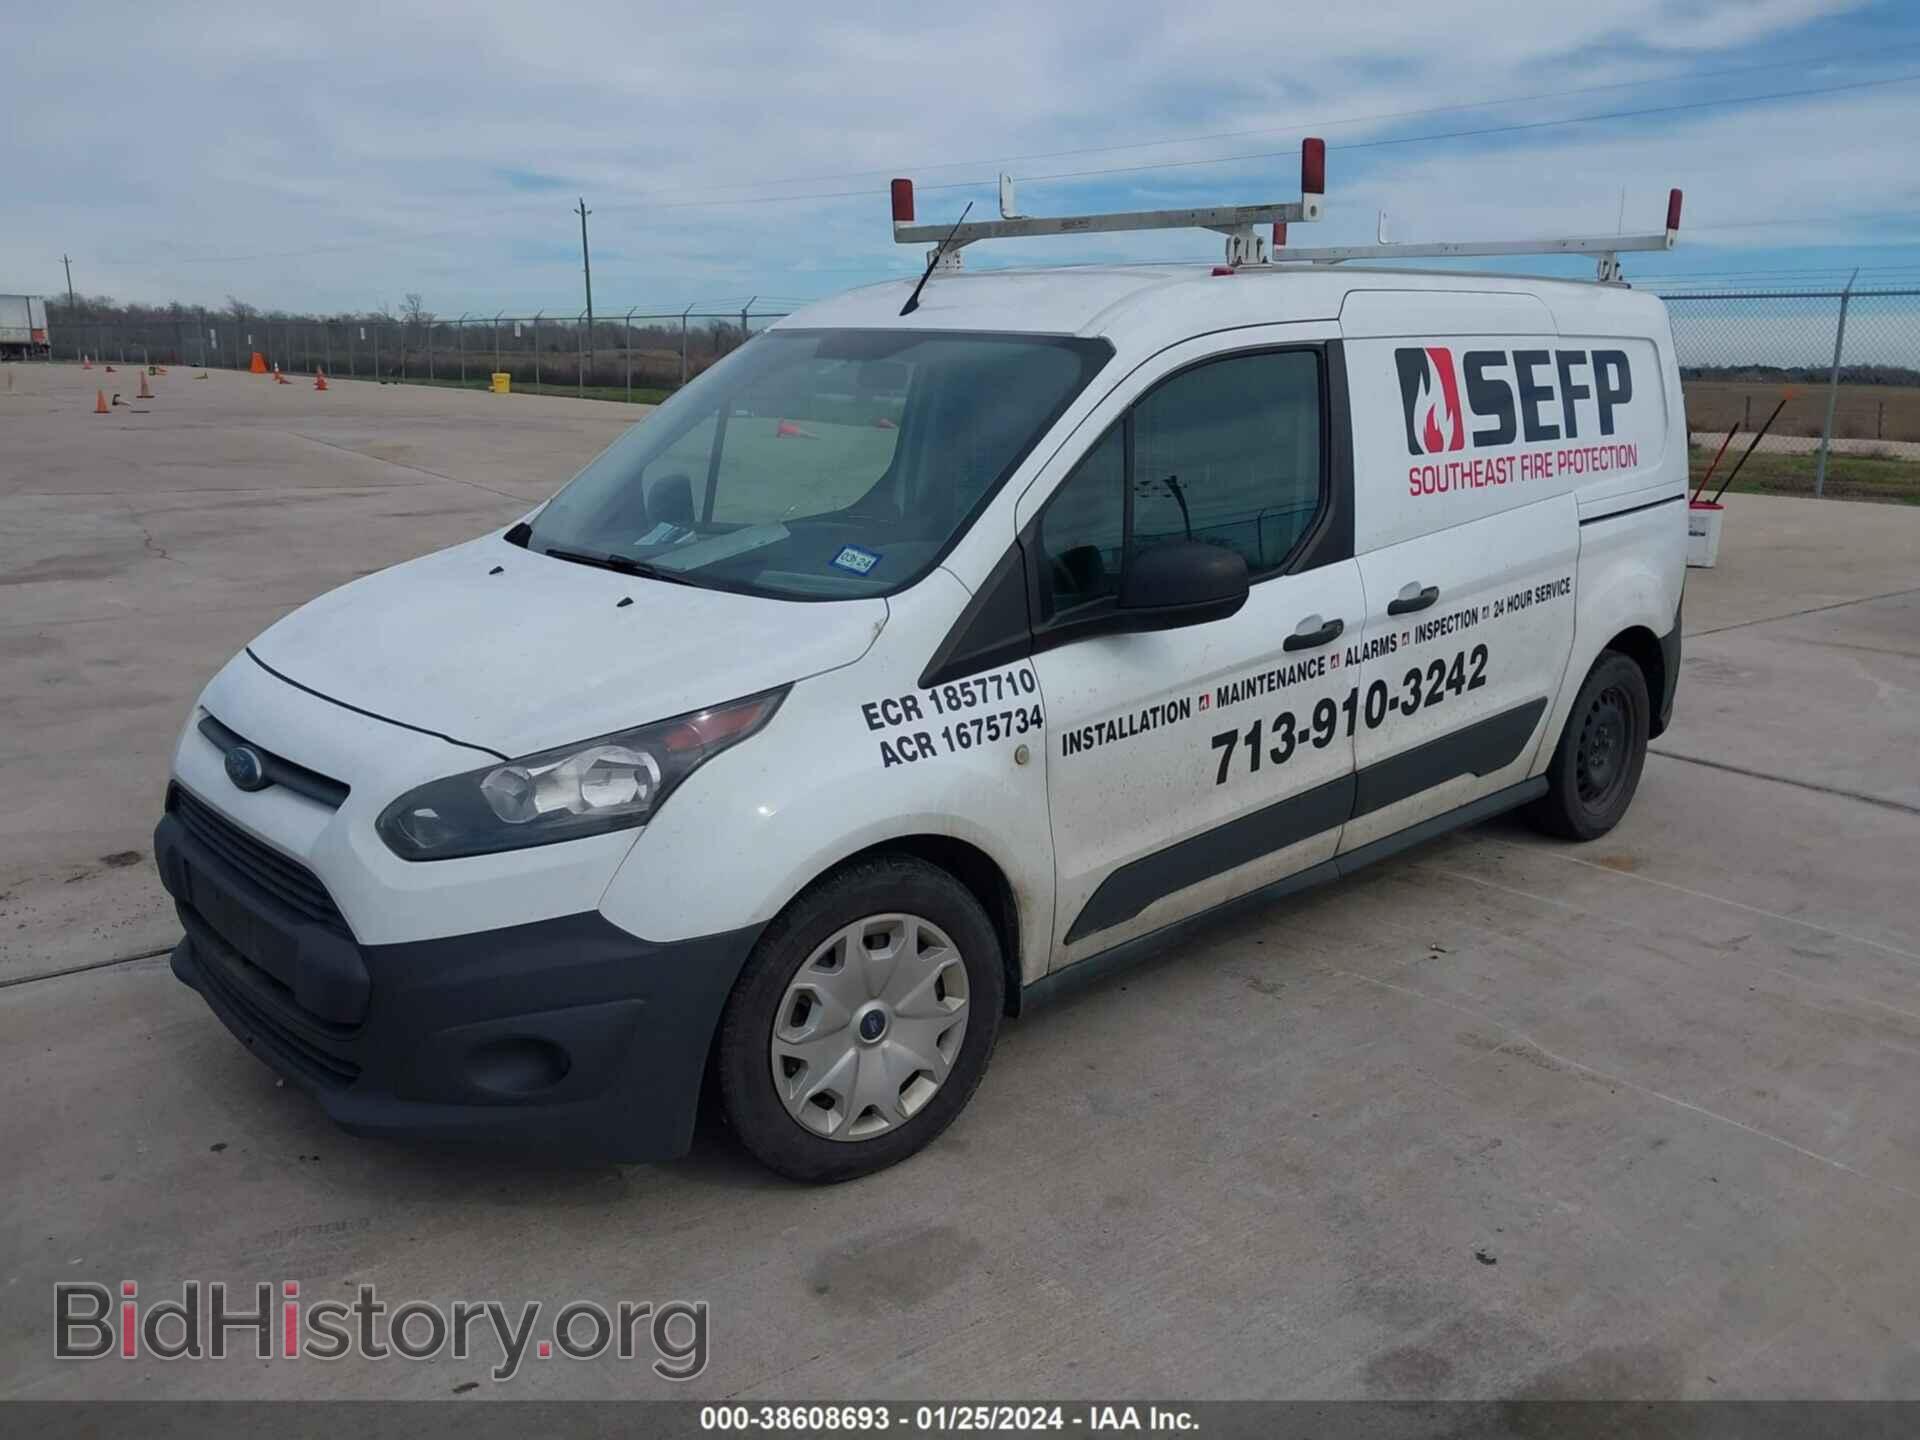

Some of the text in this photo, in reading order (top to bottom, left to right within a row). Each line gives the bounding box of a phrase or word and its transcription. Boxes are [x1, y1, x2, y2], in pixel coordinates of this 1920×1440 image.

[1463, 349, 1632, 448] SEFP
[1409, 456, 1516, 496] SOUTHEAST
[1521, 452, 1553, 481] FIRE
[861, 668, 1036, 731] ECR 1857710
[1062, 577, 1571, 757] INSTALLATION MAINTENANCE ALARMS INSPECTION 24 HOUR SERVICE
[880, 704, 1043, 768] ACR 1675734
[1211, 643, 1489, 786] 713-910-3242
